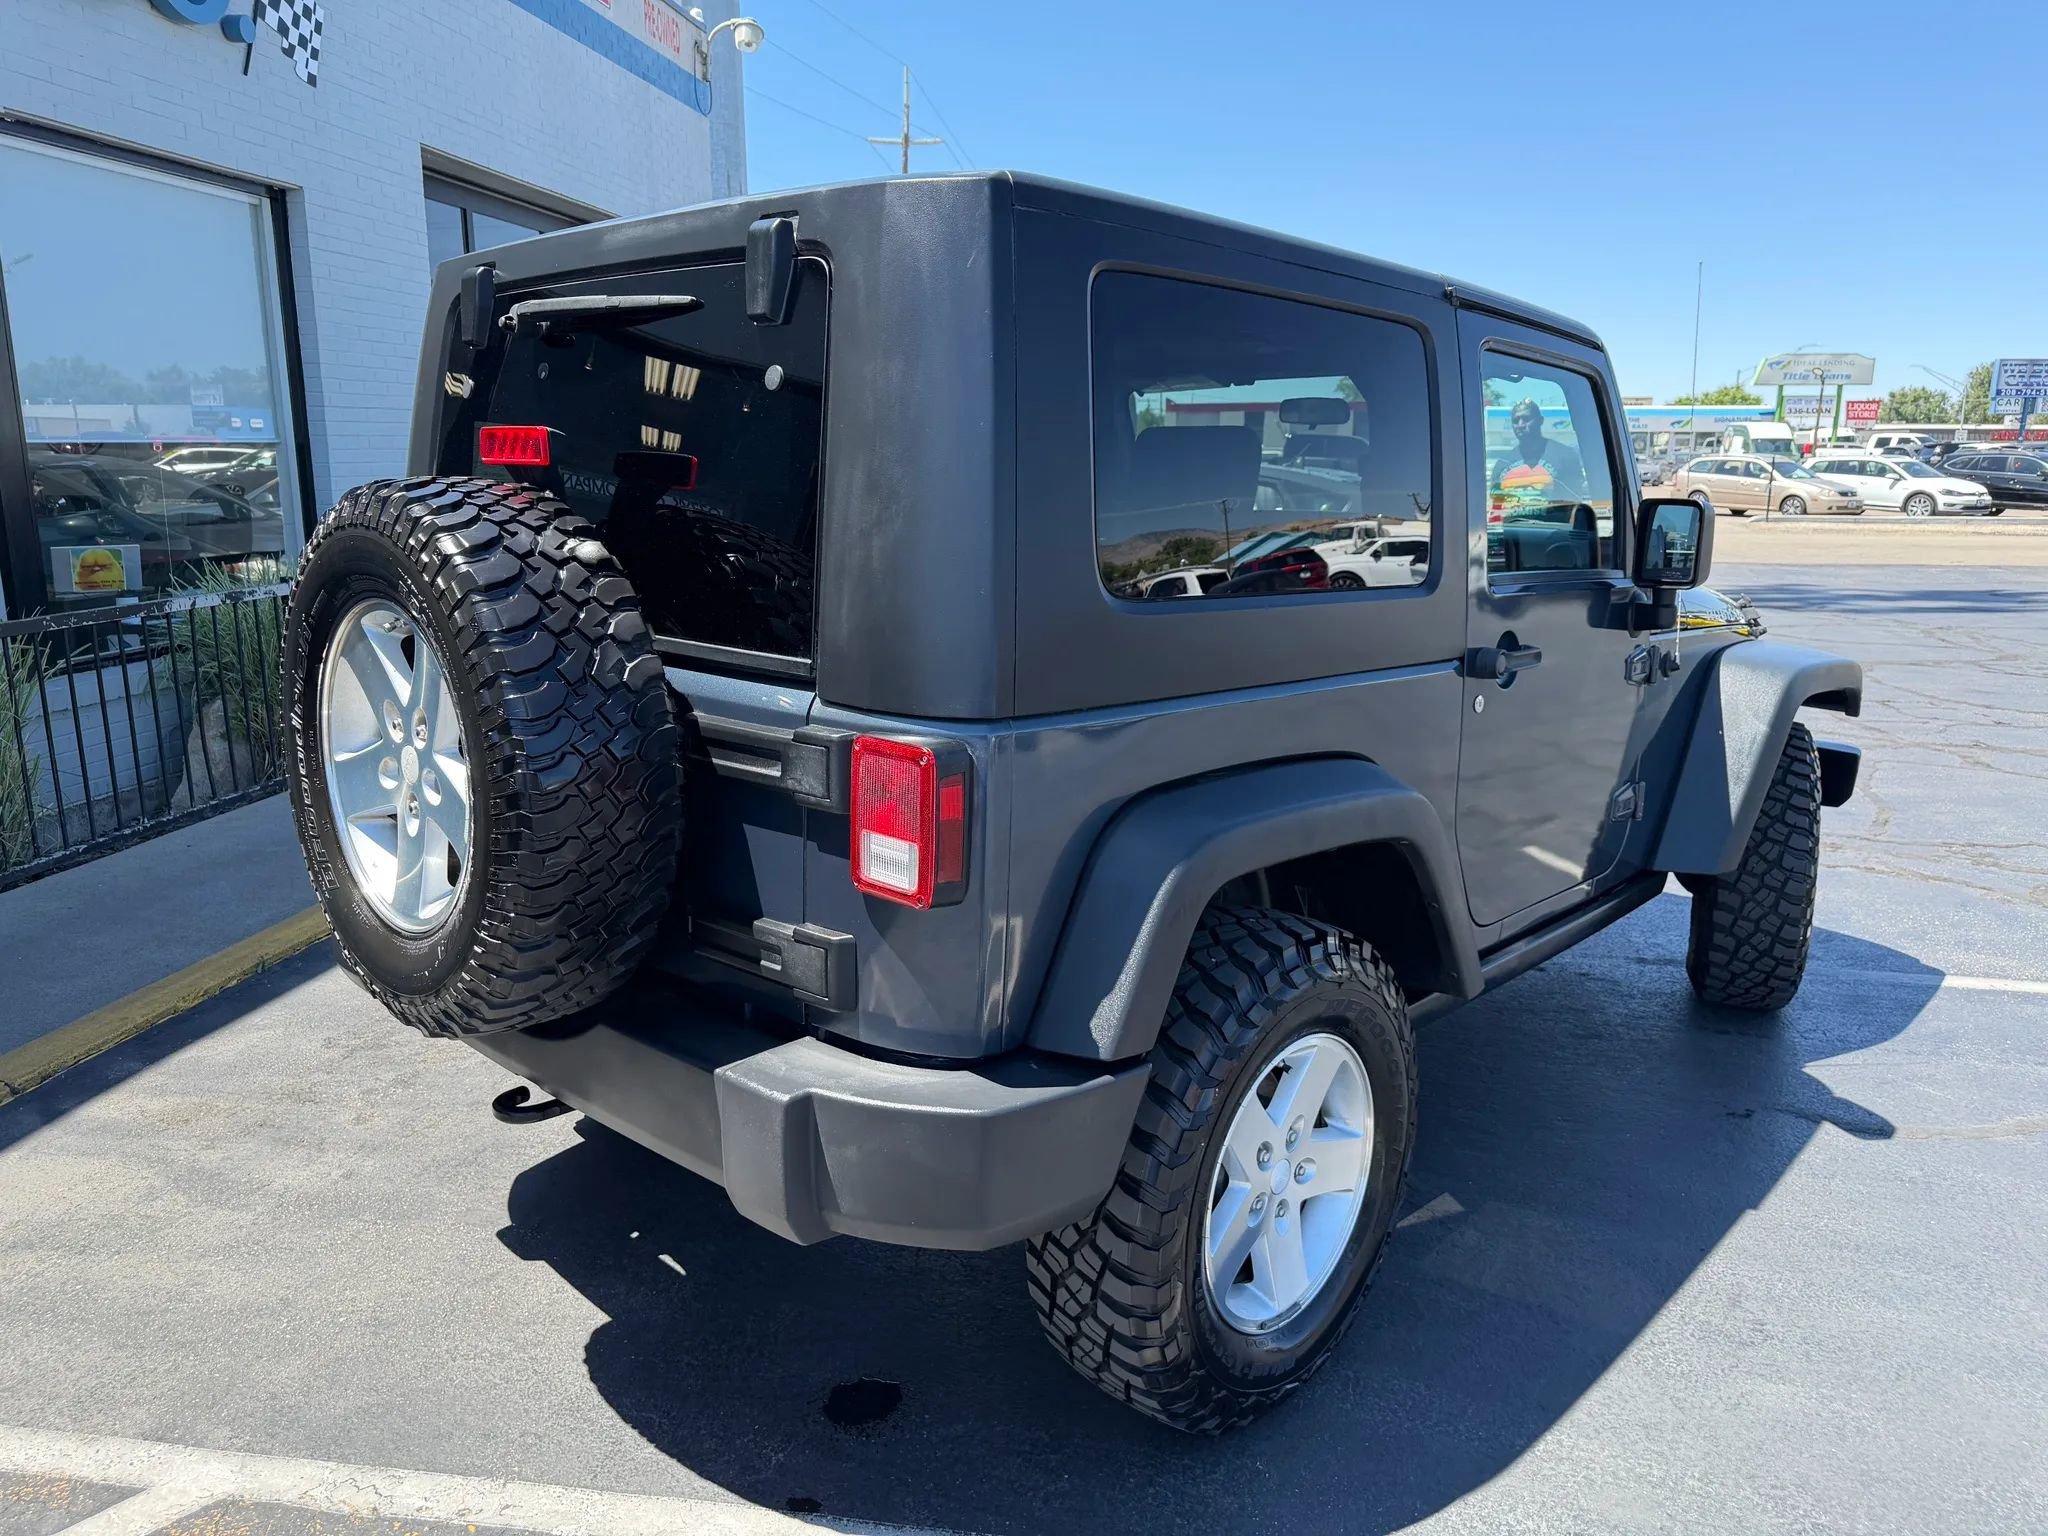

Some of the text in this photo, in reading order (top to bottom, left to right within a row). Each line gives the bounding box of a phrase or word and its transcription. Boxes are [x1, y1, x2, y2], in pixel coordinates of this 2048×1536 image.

[1782, 372, 1810, 380] Title
[1847, 401, 1879, 412] LIQUOR
[1996, 398, 2020, 407] CAR
[1847, 410, 1877, 419] STORE
